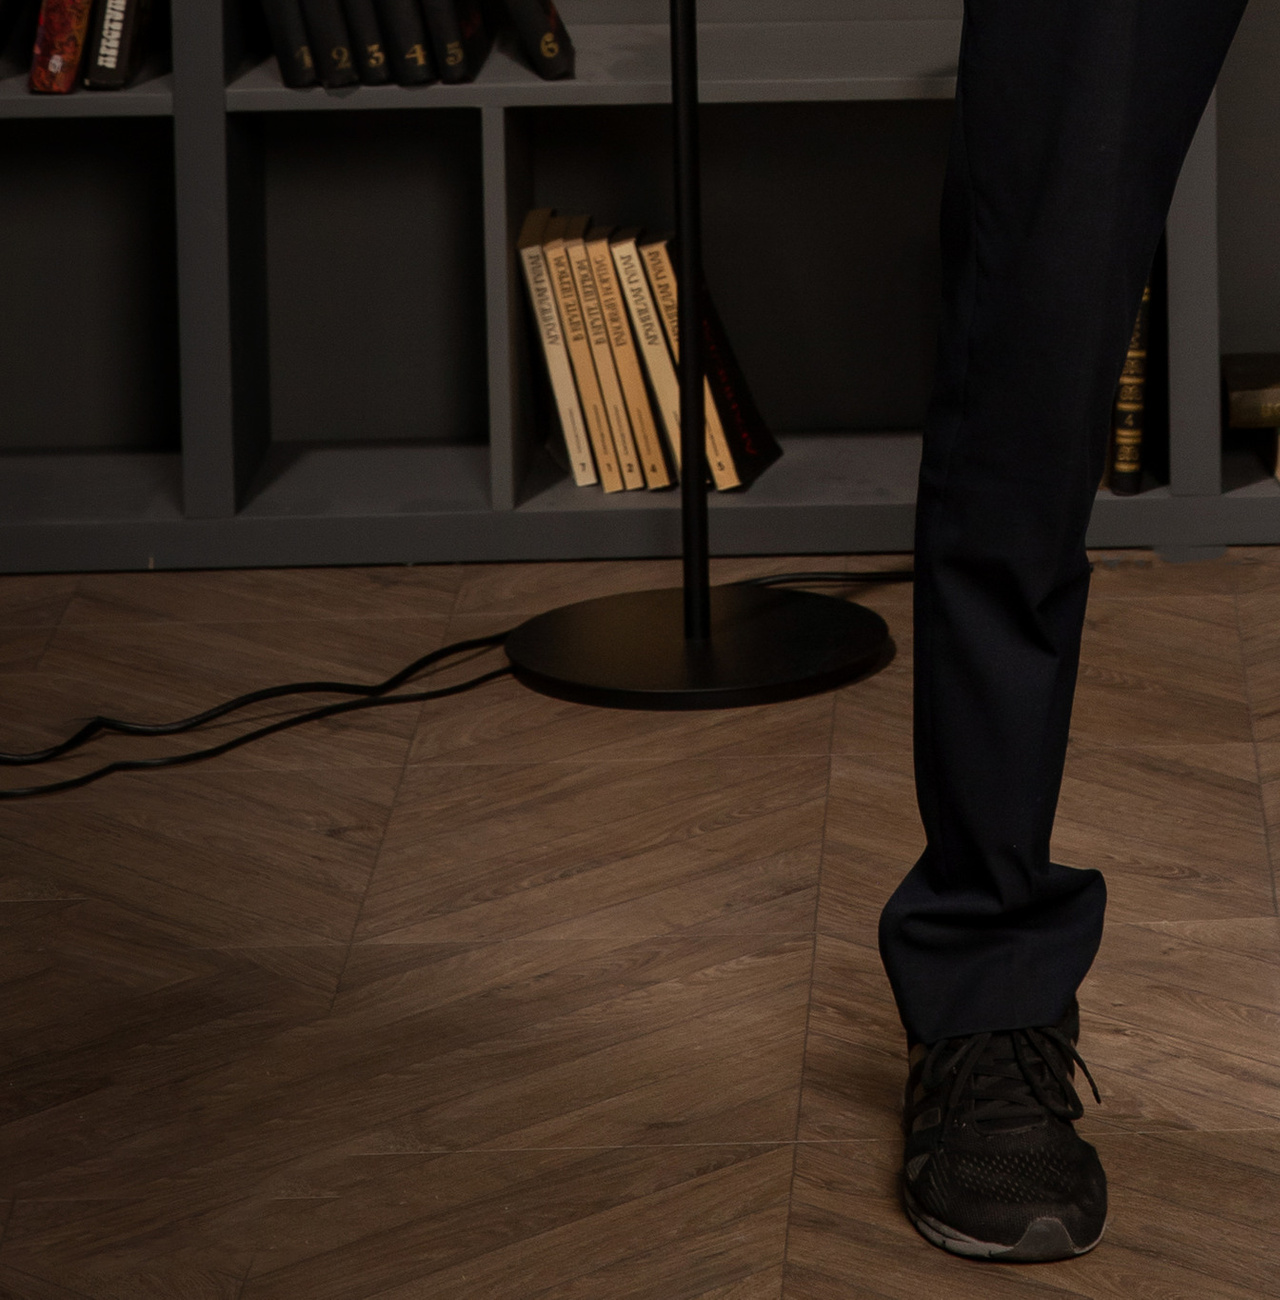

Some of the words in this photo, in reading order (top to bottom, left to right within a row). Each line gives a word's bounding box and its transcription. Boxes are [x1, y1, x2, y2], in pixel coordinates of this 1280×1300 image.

[368, 44, 386, 67] 3
[405, 44, 427, 67] 4
[446, 42, 465, 66] 5
[541, 32, 559, 58] 6
[332, 46, 352, 69] 2
[618, 252, 639, 285] ГУЛАГ
[629, 285, 660, 348] АРХИПЕЛАГ
